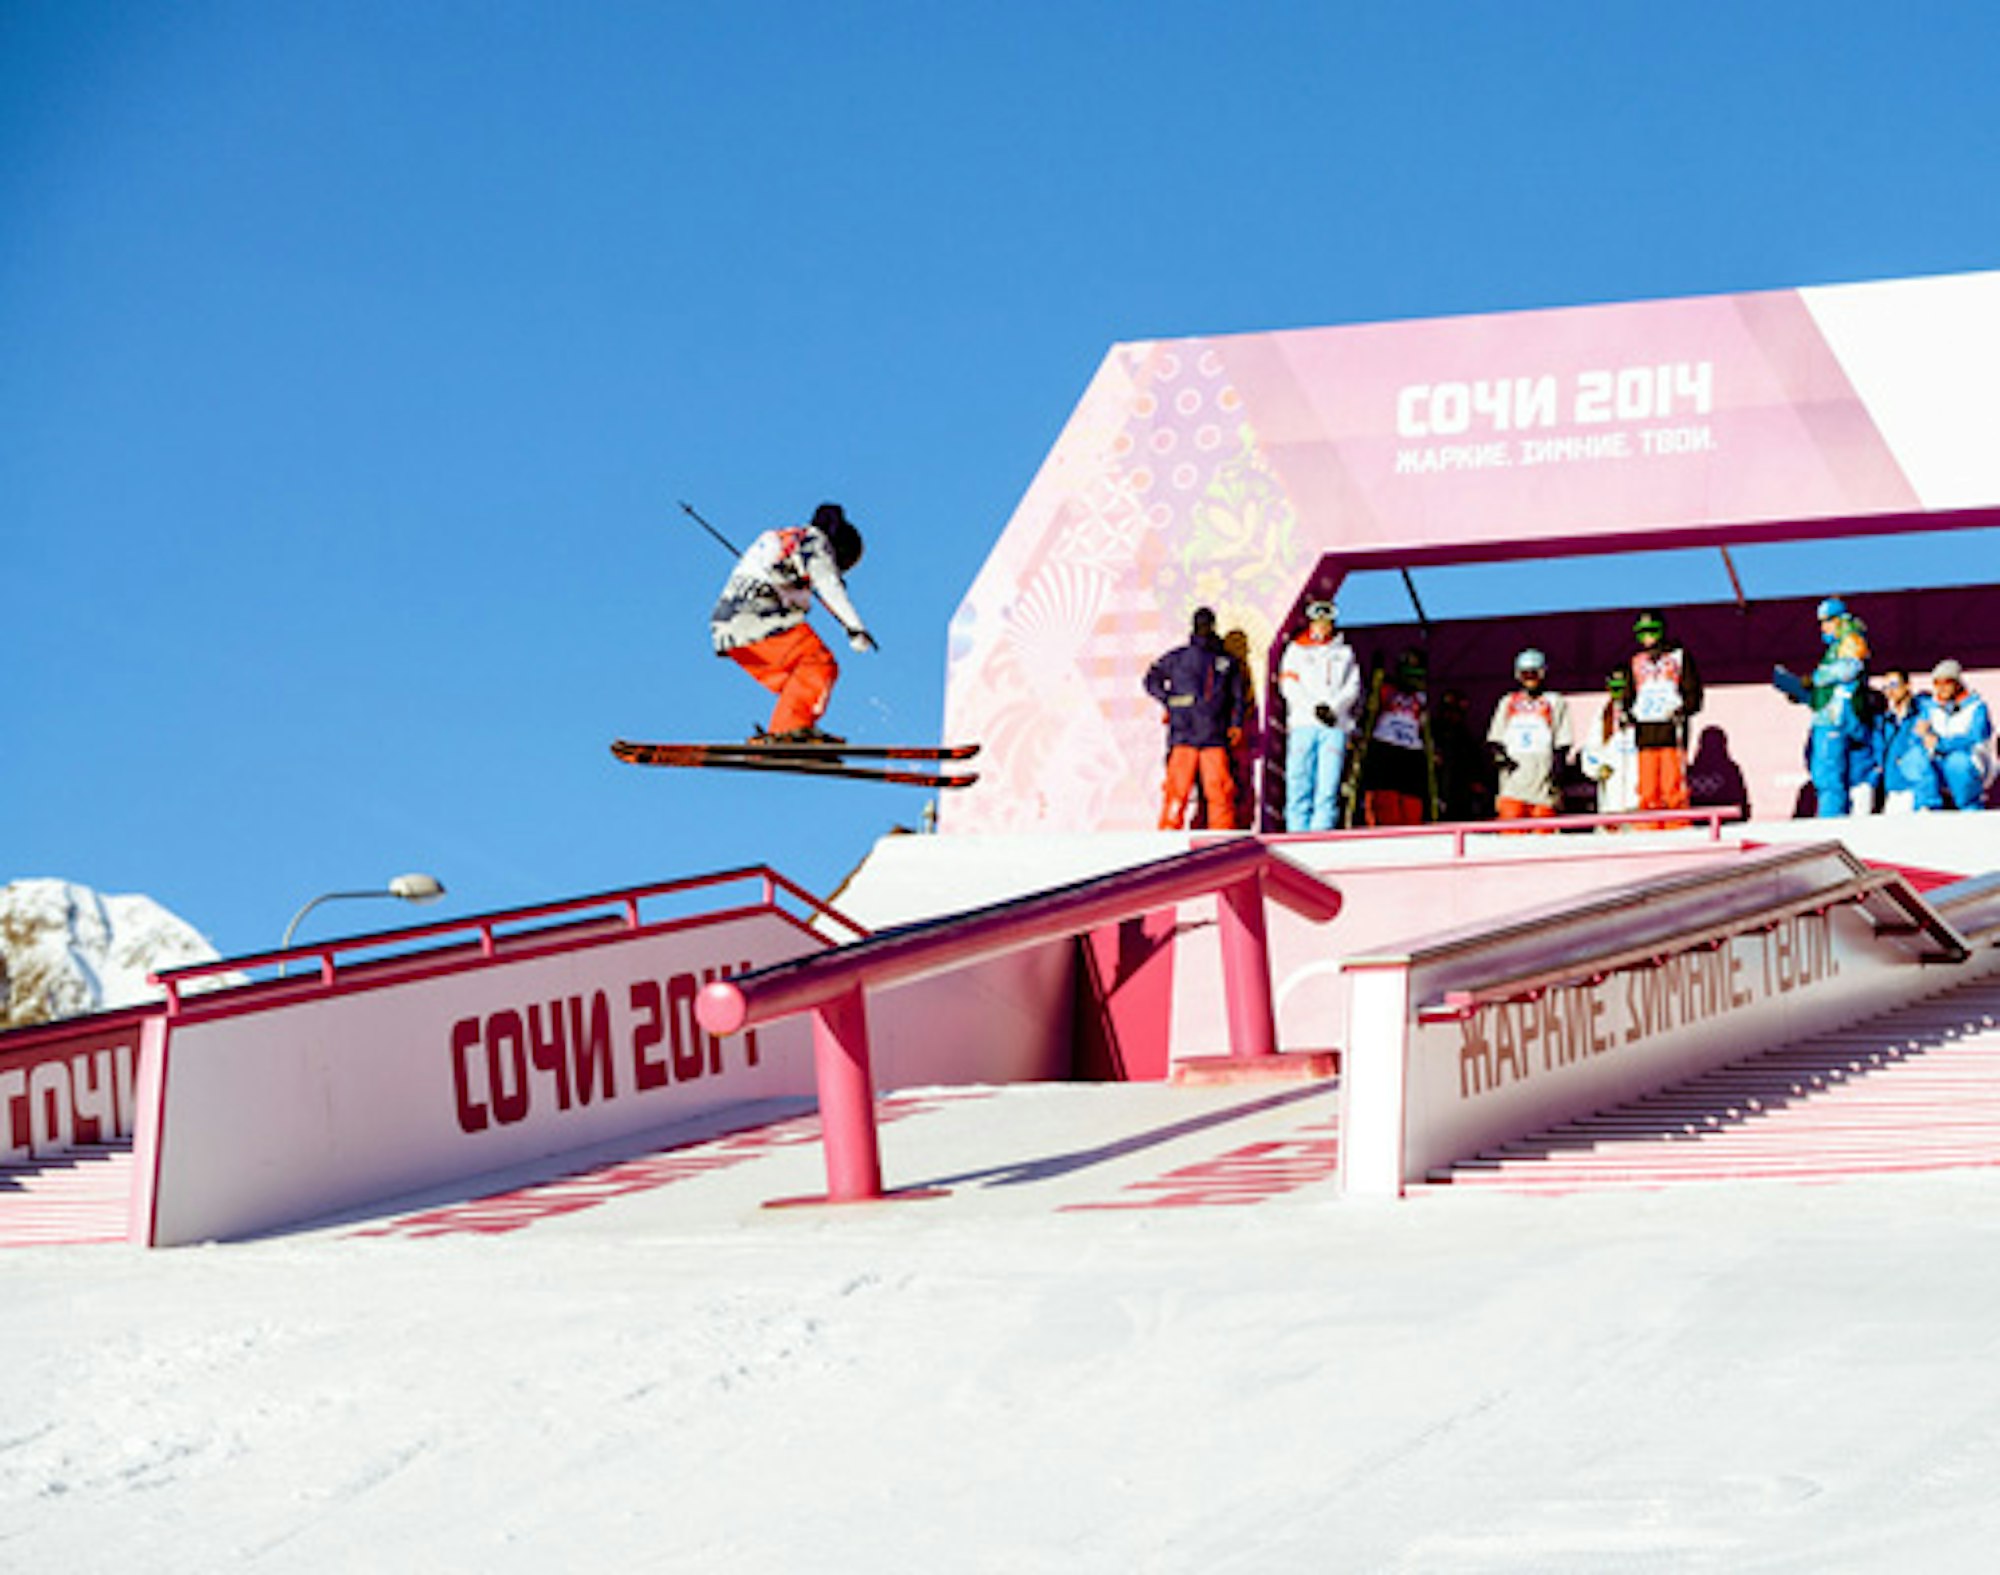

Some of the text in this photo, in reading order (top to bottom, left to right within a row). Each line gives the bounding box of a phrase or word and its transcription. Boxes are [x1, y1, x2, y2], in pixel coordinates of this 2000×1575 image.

[1397, 361, 1713, 438] СОЧИ 2014
[451, 990, 616, 1133] СОЧИ
